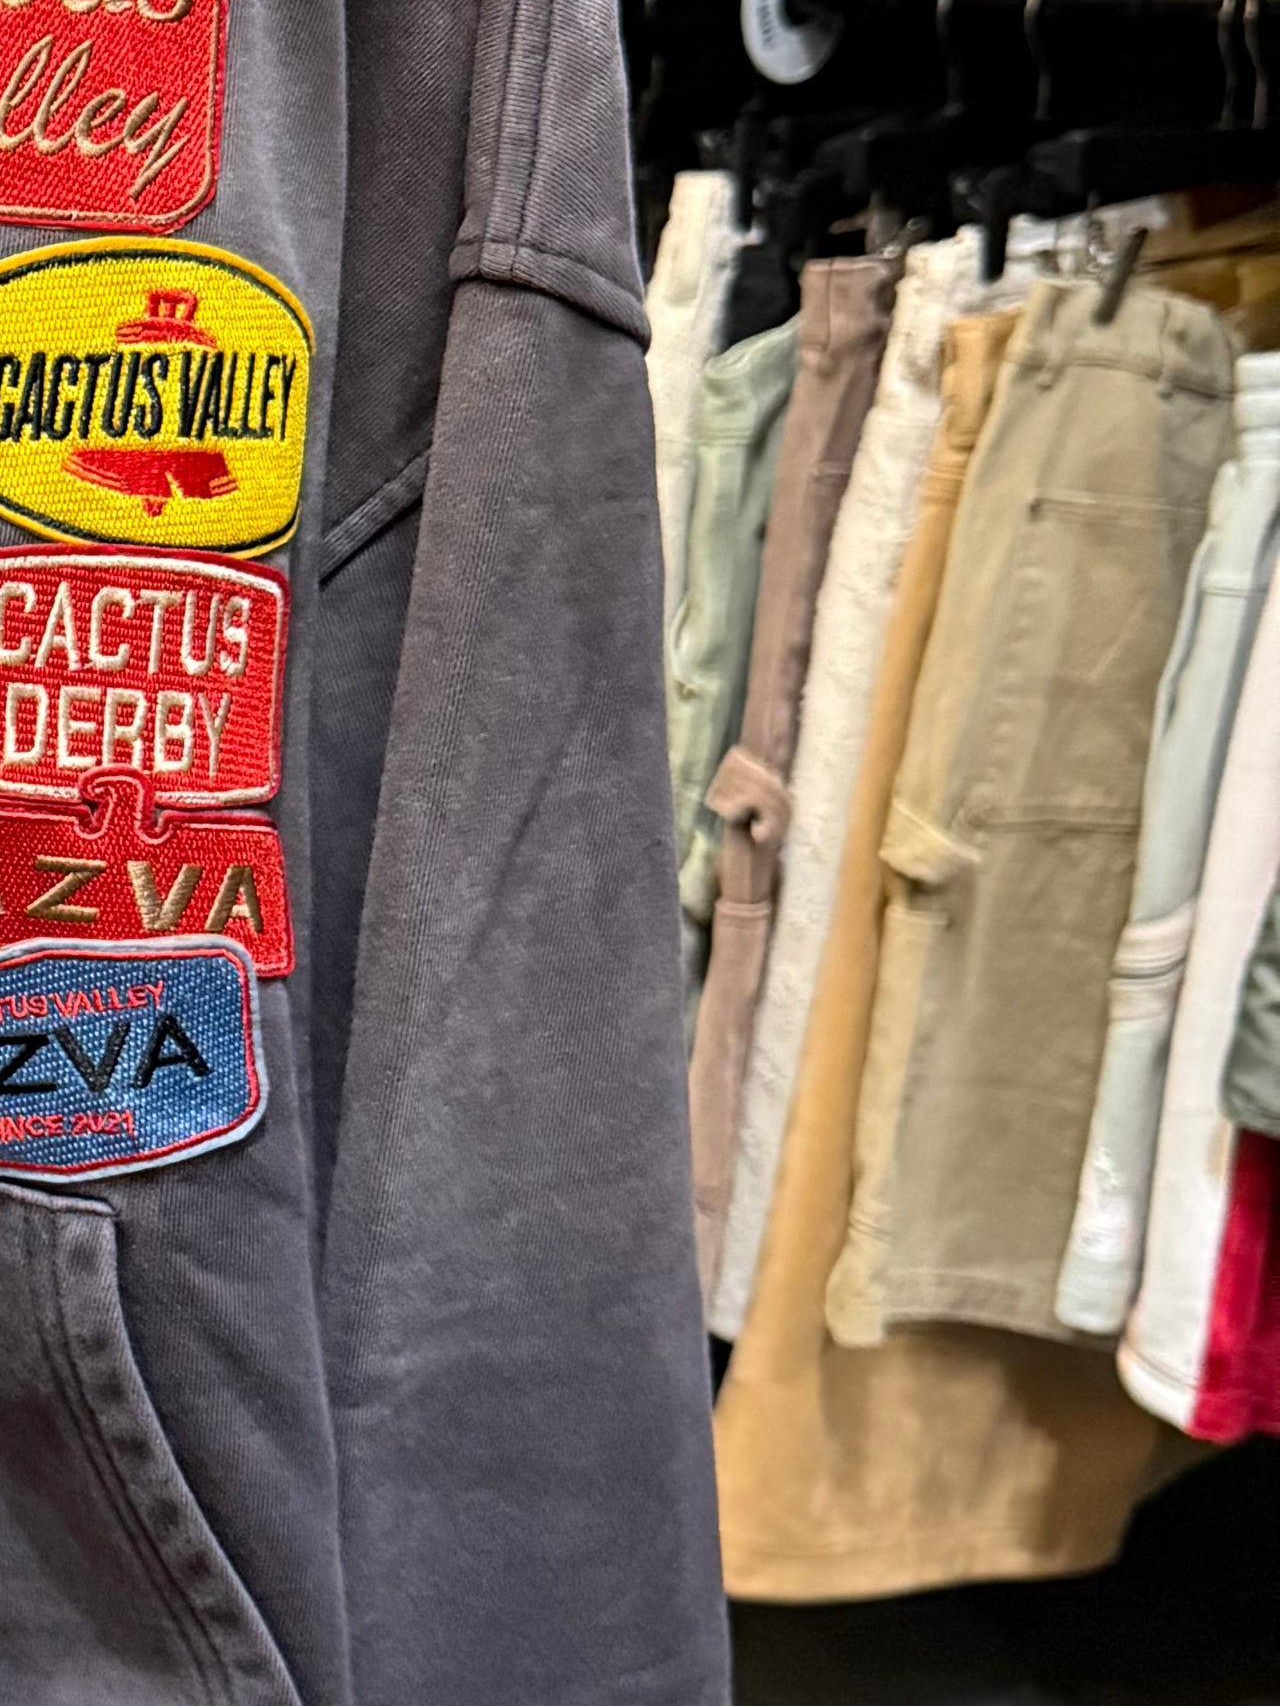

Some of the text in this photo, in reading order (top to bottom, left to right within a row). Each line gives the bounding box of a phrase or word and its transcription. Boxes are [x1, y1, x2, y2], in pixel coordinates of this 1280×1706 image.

[177, 350, 297, 441] VALLEY
[1, 682, 231, 780] DERBY
[48, 981, 165, 1018] VALLEY
[69, 1109, 137, 1140] 2021
